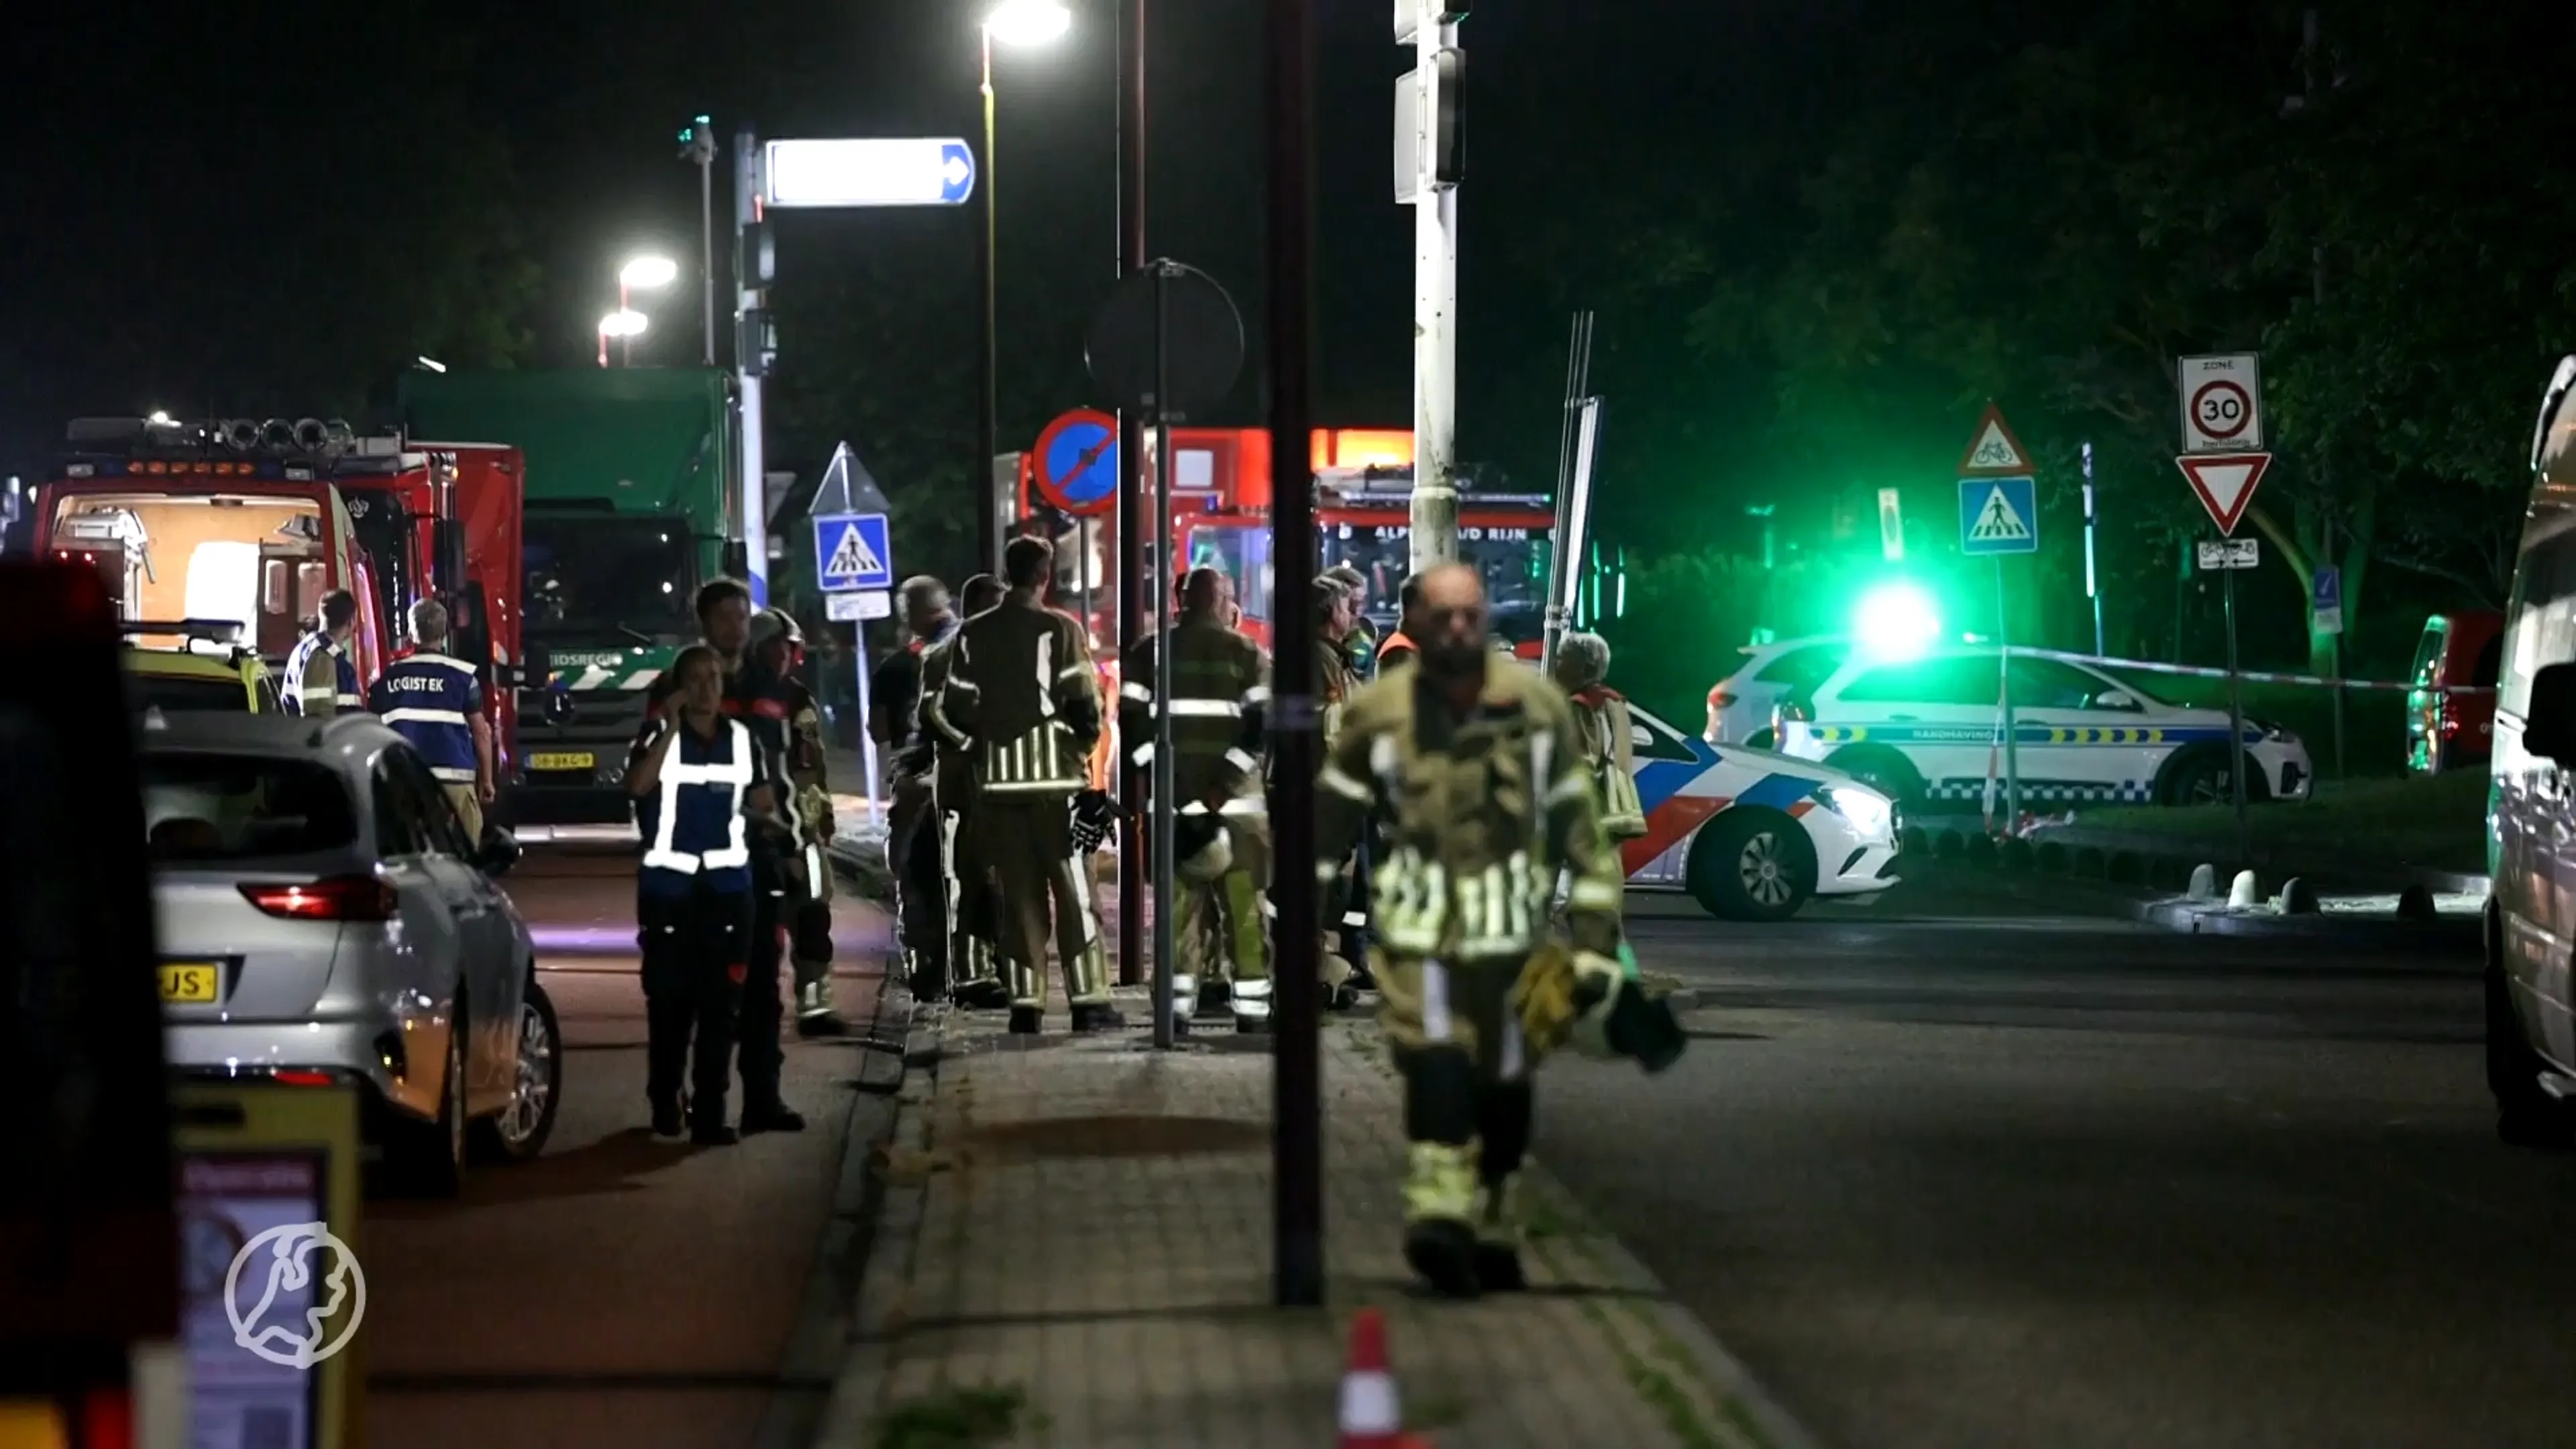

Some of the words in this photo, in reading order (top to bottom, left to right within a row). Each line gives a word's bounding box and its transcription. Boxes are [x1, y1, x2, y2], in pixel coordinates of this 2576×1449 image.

[2202, 360, 2234, 370] ZONE
[2203, 398, 2239, 421] 30
[1488, 528, 1527, 541] RIJN
[387, 676, 444, 694] LOGISTEK
